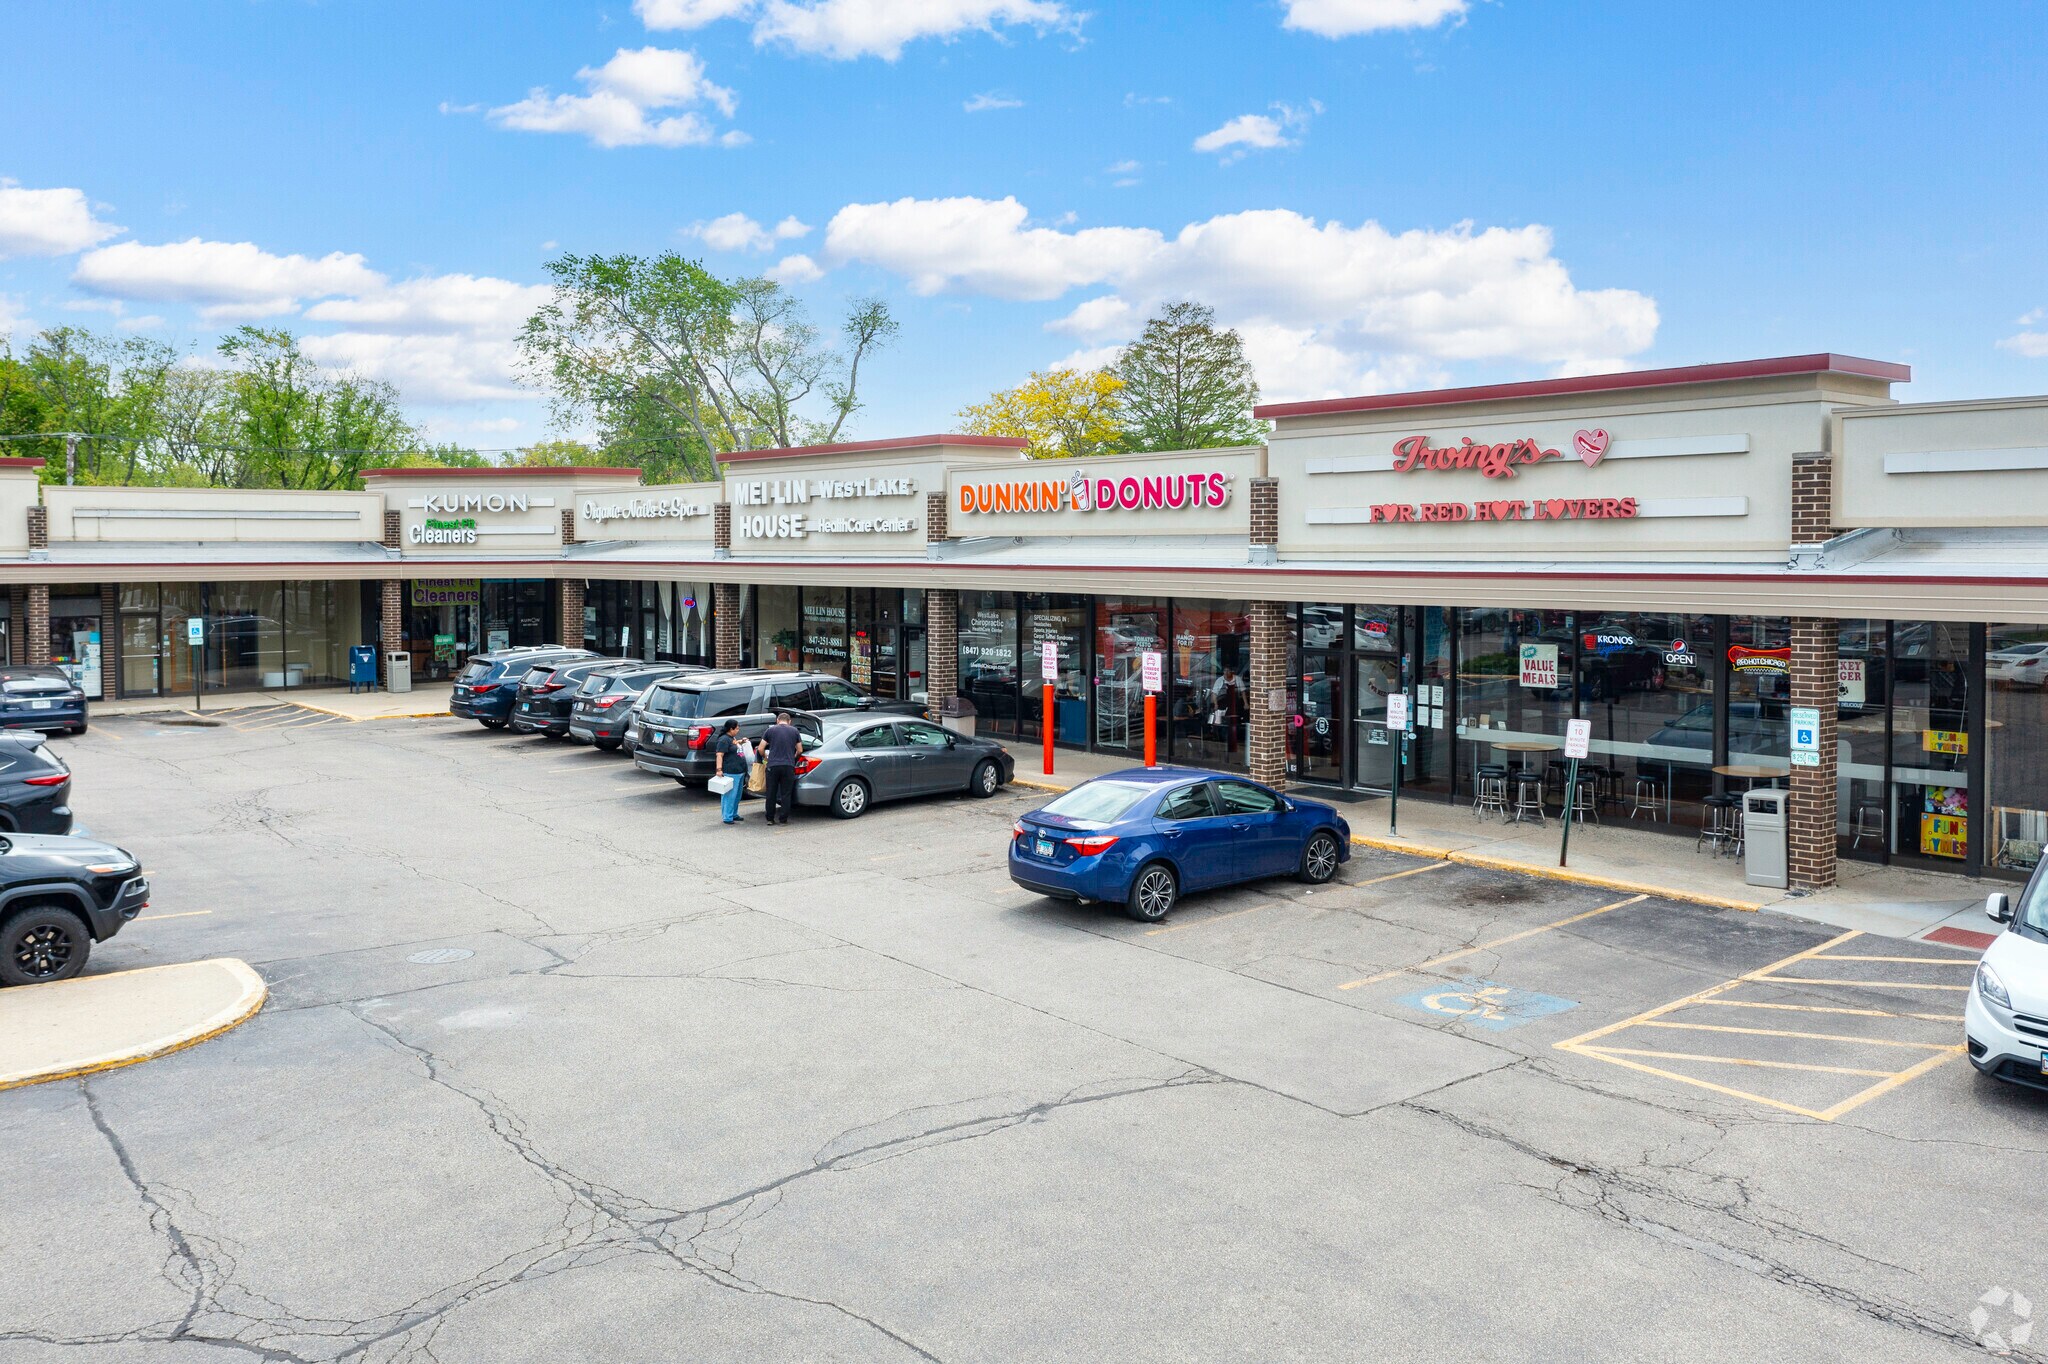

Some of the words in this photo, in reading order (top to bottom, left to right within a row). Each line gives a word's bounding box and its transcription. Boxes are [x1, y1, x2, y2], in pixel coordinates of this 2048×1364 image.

[1392, 435, 1561, 478] Irving's
[735, 481, 767, 505] MEI
[774, 480, 807, 504] LIN
[960, 480, 1066, 513] DUNKIN'
[1097, 472, 1226, 510] DONUTS
[423, 494, 528, 512] KUMON
[583, 500, 619, 523] Organic
[622, 499, 655, 518] Nails
[658, 500, 669, 517] &
[670, 497, 695, 521] Spa
[1420, 503, 1468, 522] RED
[426, 519, 459, 529] Finest
[461, 518, 475, 528] Fit
[739, 514, 803, 538] HOUSE
[874, 517, 909, 532] Center
[409, 524, 477, 544] Cleaners
[414, 589, 479, 602] Cleaners
[826, 607, 846, 617] HOUSE
[971, 618, 1004, 627] Chiropractic
[1364, 622, 1388, 633] OPEN
[1597, 635, 1634, 645] KRONOS
[963, 646, 979, 655] (847)
[981, 647, 1012, 657] 920-1822
[1524, 659, 1554, 672] VALUE
[1666, 654, 1693, 665] OPEN
[1760, 657, 1786, 668] CHICAGO
[1522, 672, 1556, 685] MEALS
[1938, 731, 1957, 742] FUN
[1933, 818, 1959, 836] FUN
[1924, 836, 1968, 857] TYMES
